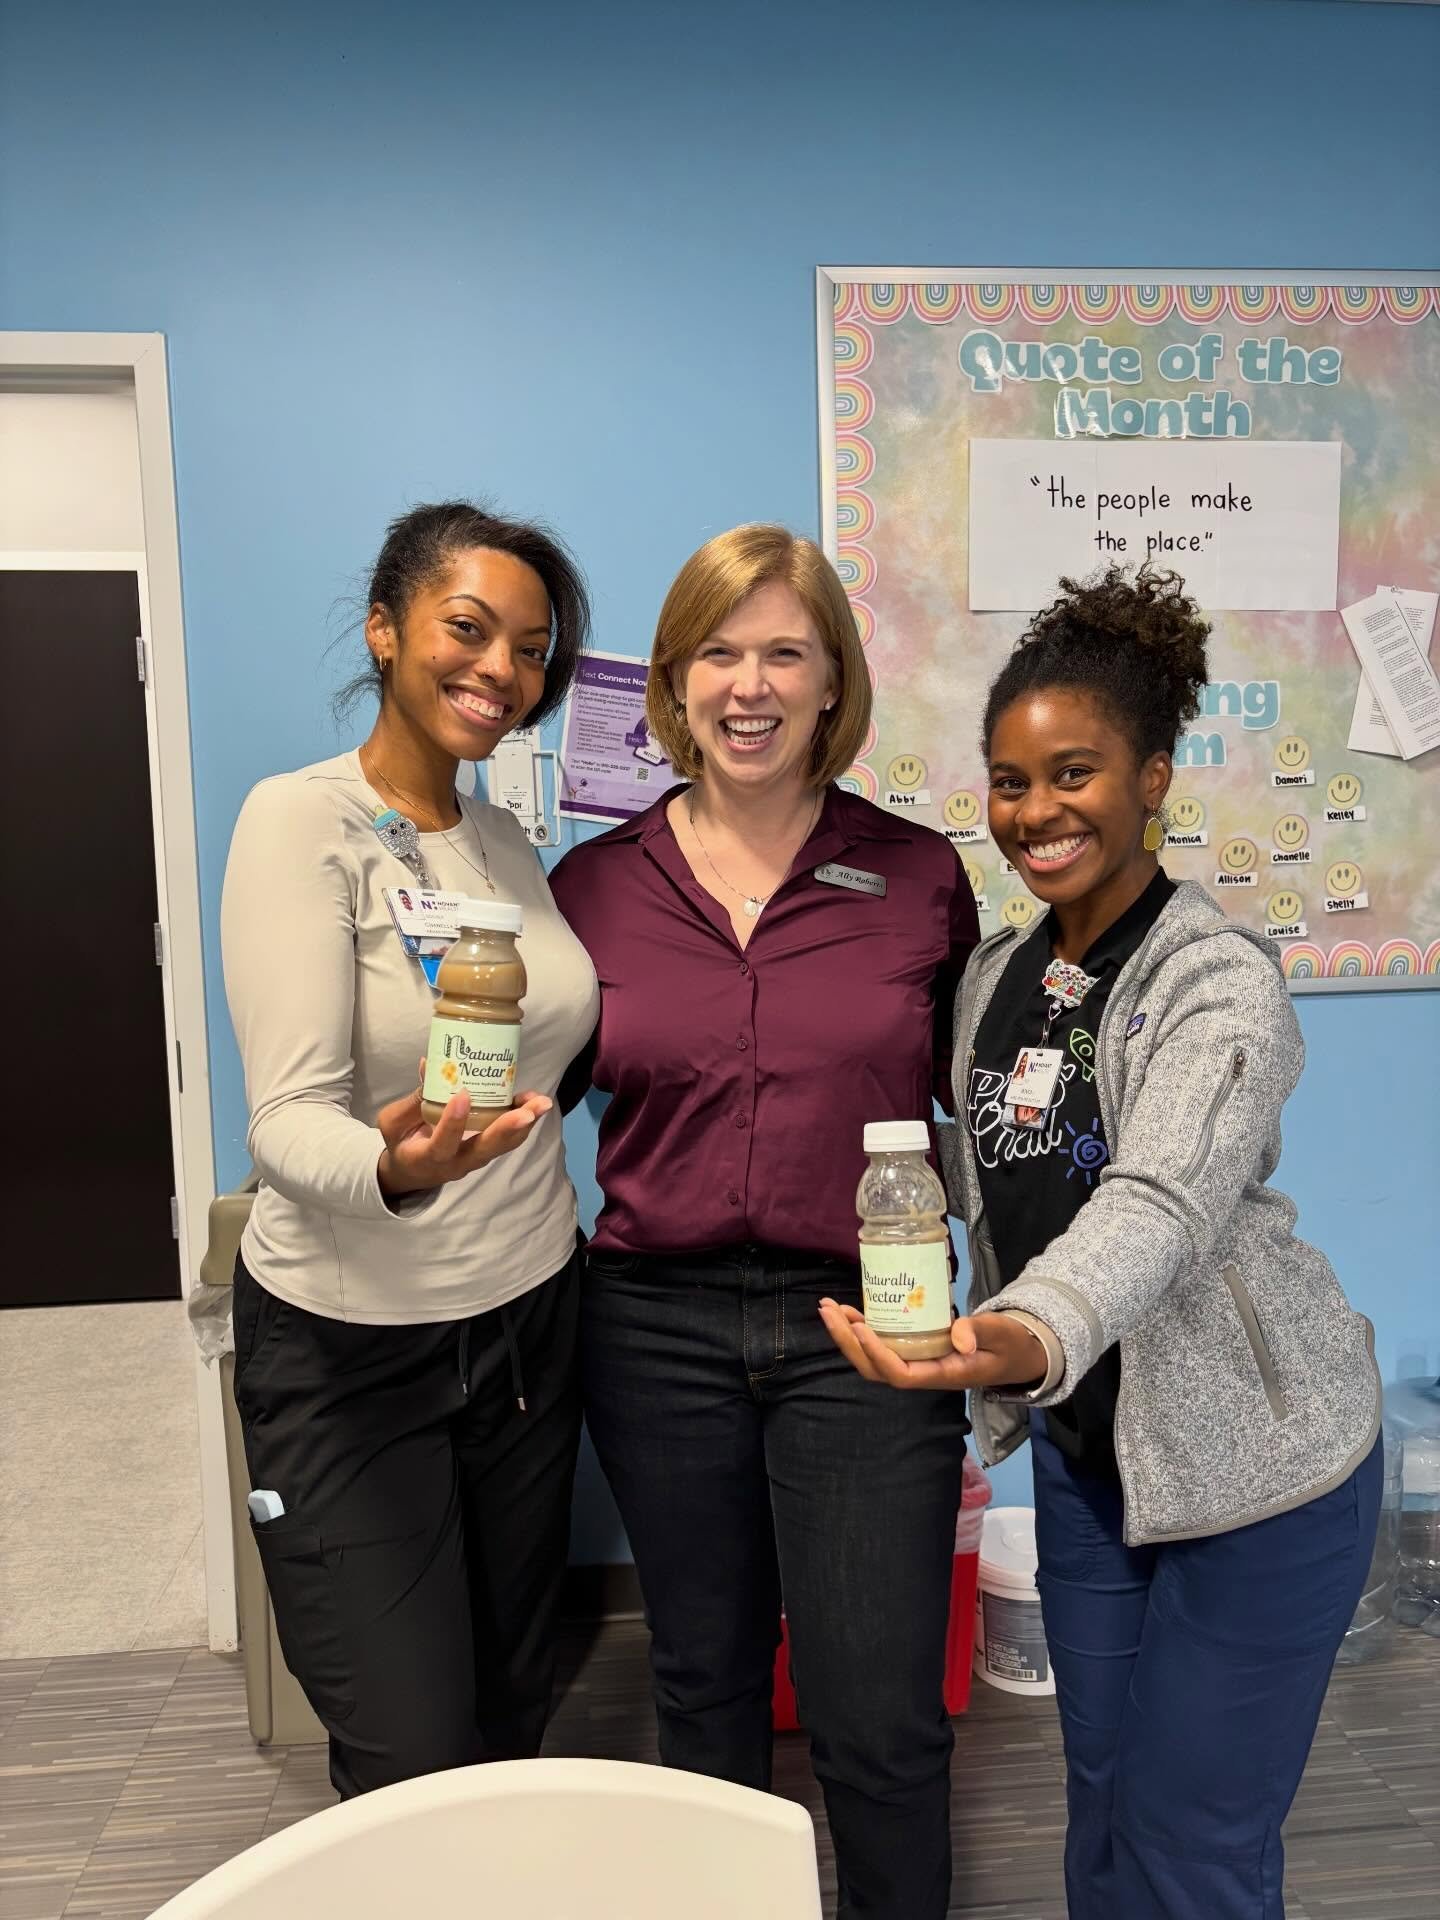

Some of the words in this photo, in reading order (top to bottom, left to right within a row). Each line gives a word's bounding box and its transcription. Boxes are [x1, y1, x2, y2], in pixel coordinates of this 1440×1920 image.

[959, 330, 1143, 391] Quote
[1158, 334, 1224, 382] of
[1237, 337, 1342, 385] the
[1055, 387, 1252, 439] Month
[1098, 485, 1170, 520] people
[1192, 482, 1253, 511] make
[1094, 530, 1127, 551] the
[580, 669, 597, 679] Text
[598, 672, 632, 685] Connect
[1275, 774, 1307, 785] Damari
[889, 794, 916, 804] Abby
[509, 802, 522, 810] PDI
[1327, 810, 1355, 821] Kelley
[945, 829, 977, 839] Megan
[1167, 834, 1202, 845] Monica
[1272, 851, 1310, 862] Chanelle
[1218, 875, 1251, 885] Allison
[1327, 899, 1355, 909] Shelly
[1268, 925, 1300, 936] Louise
[459, 1061, 507, 1078] Nectar
[865, 1287, 906, 1304] Nectar
